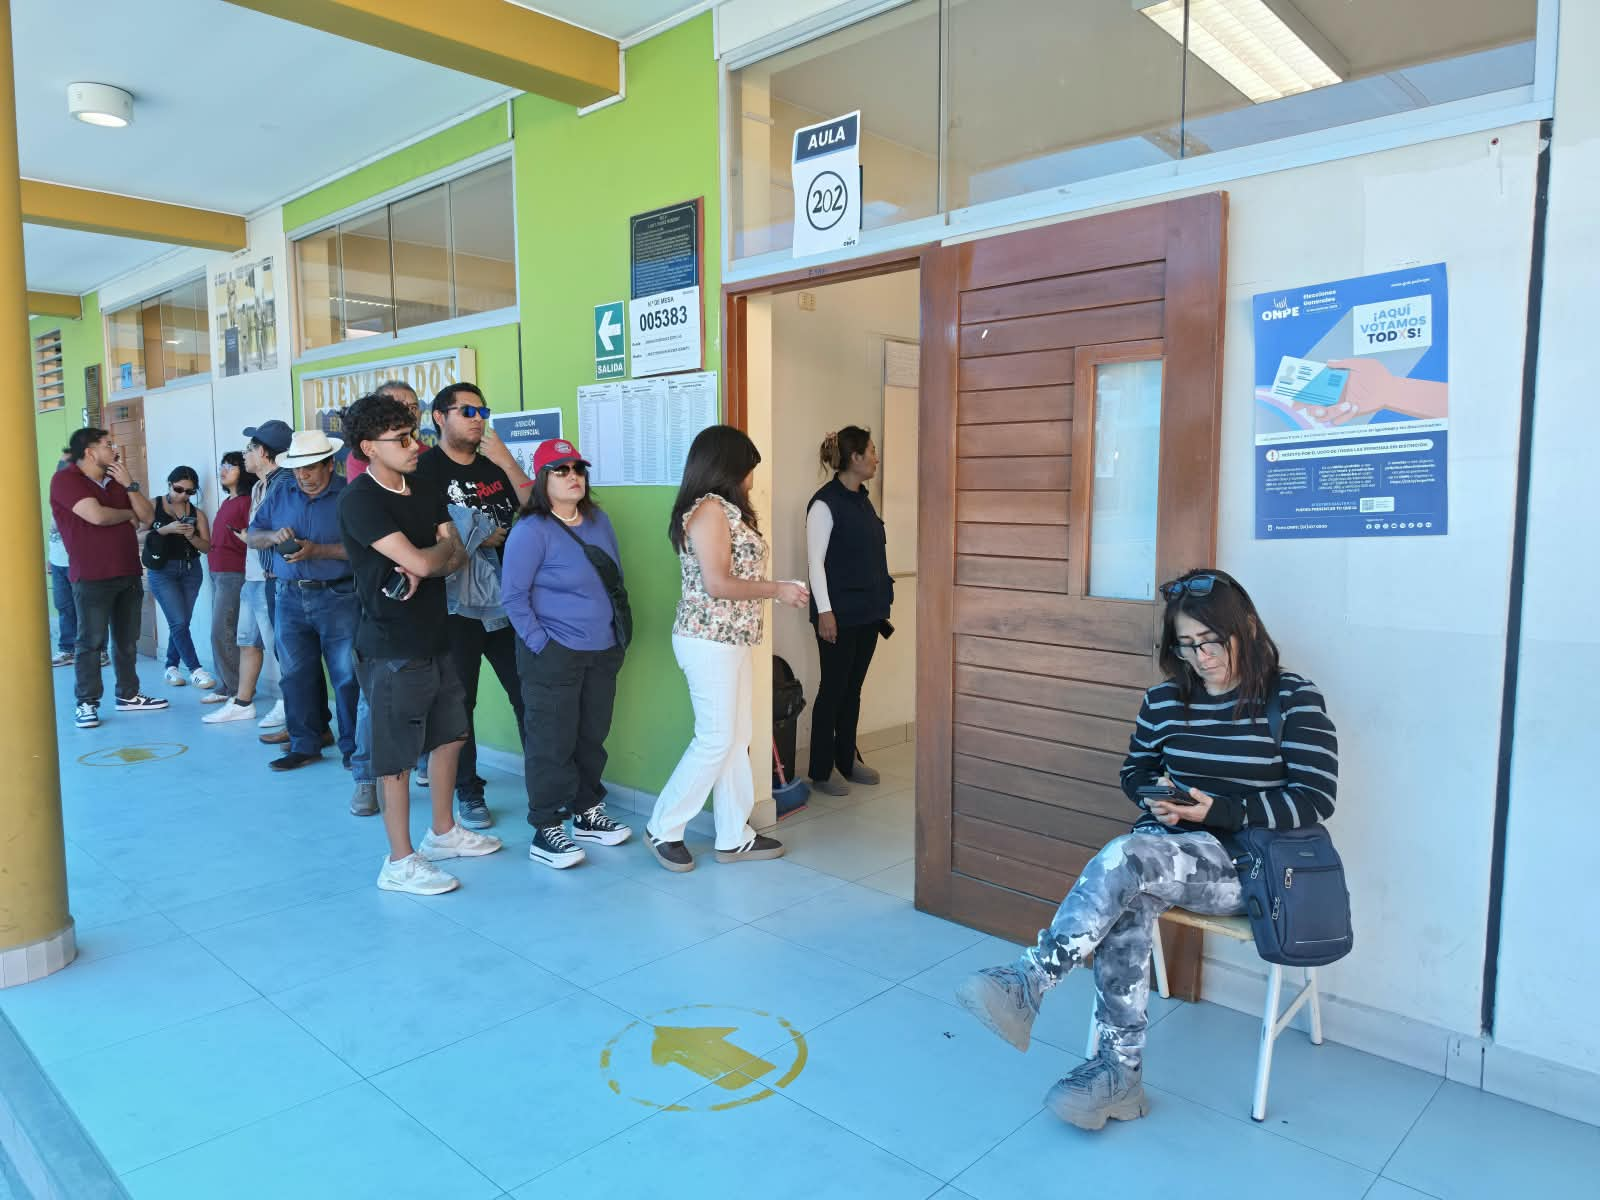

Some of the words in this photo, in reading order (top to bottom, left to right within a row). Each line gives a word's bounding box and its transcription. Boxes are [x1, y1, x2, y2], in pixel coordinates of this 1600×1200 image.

[807, 126, 846, 150] AULA
[812, 185, 843, 213] 202
[661, 296, 675, 304] MESA
[640, 305, 688, 331] 005383
[1262, 306, 1300, 321] ONPE
[1373, 303, 1411, 322] ¡AQUÍ
[1360, 315, 1427, 334] VOTAMOS
[597, 361, 624, 375] SALIDA
[314, 359, 456, 409] BIENVENIDOS
